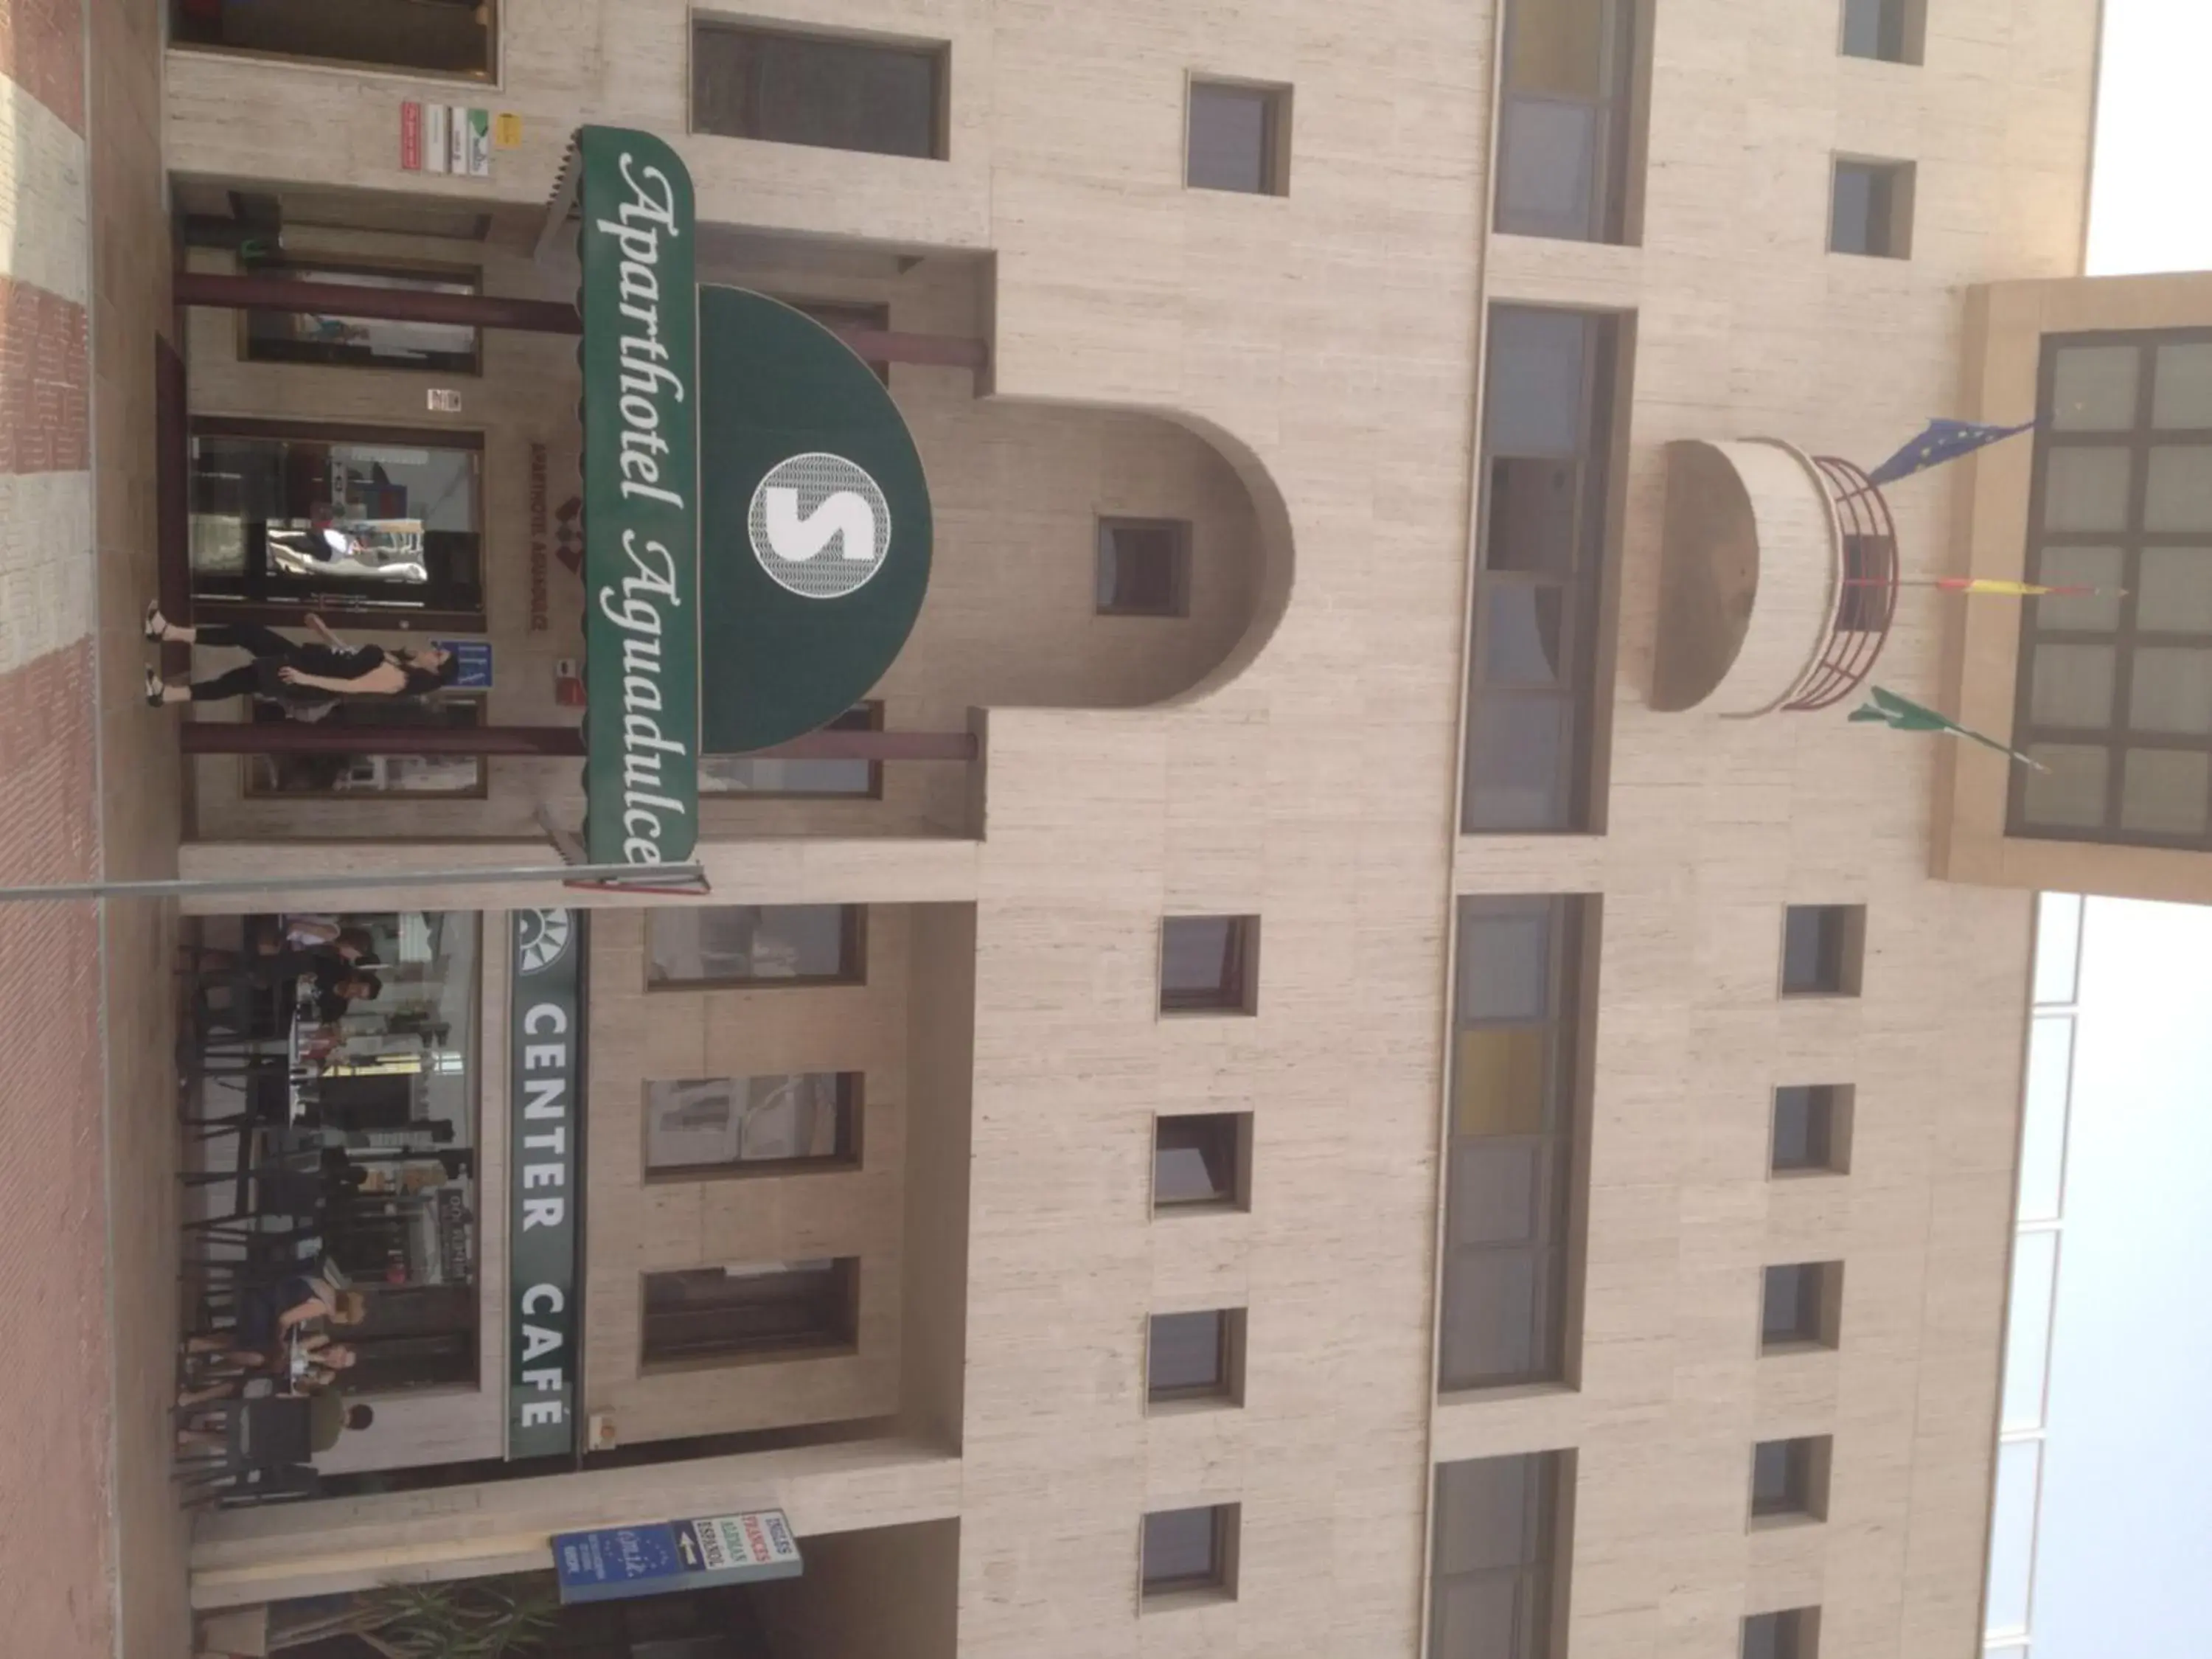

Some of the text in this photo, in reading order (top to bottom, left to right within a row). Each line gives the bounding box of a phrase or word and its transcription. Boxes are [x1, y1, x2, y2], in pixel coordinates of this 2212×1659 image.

[529, 442, 549, 633] APARTHOTEL AGUADULCE
[596, 152, 686, 865] Aparthotel Aguadulce
[765, 487, 874, 561] S
[521, 1002, 571, 1427] CENTER CAFÉ
